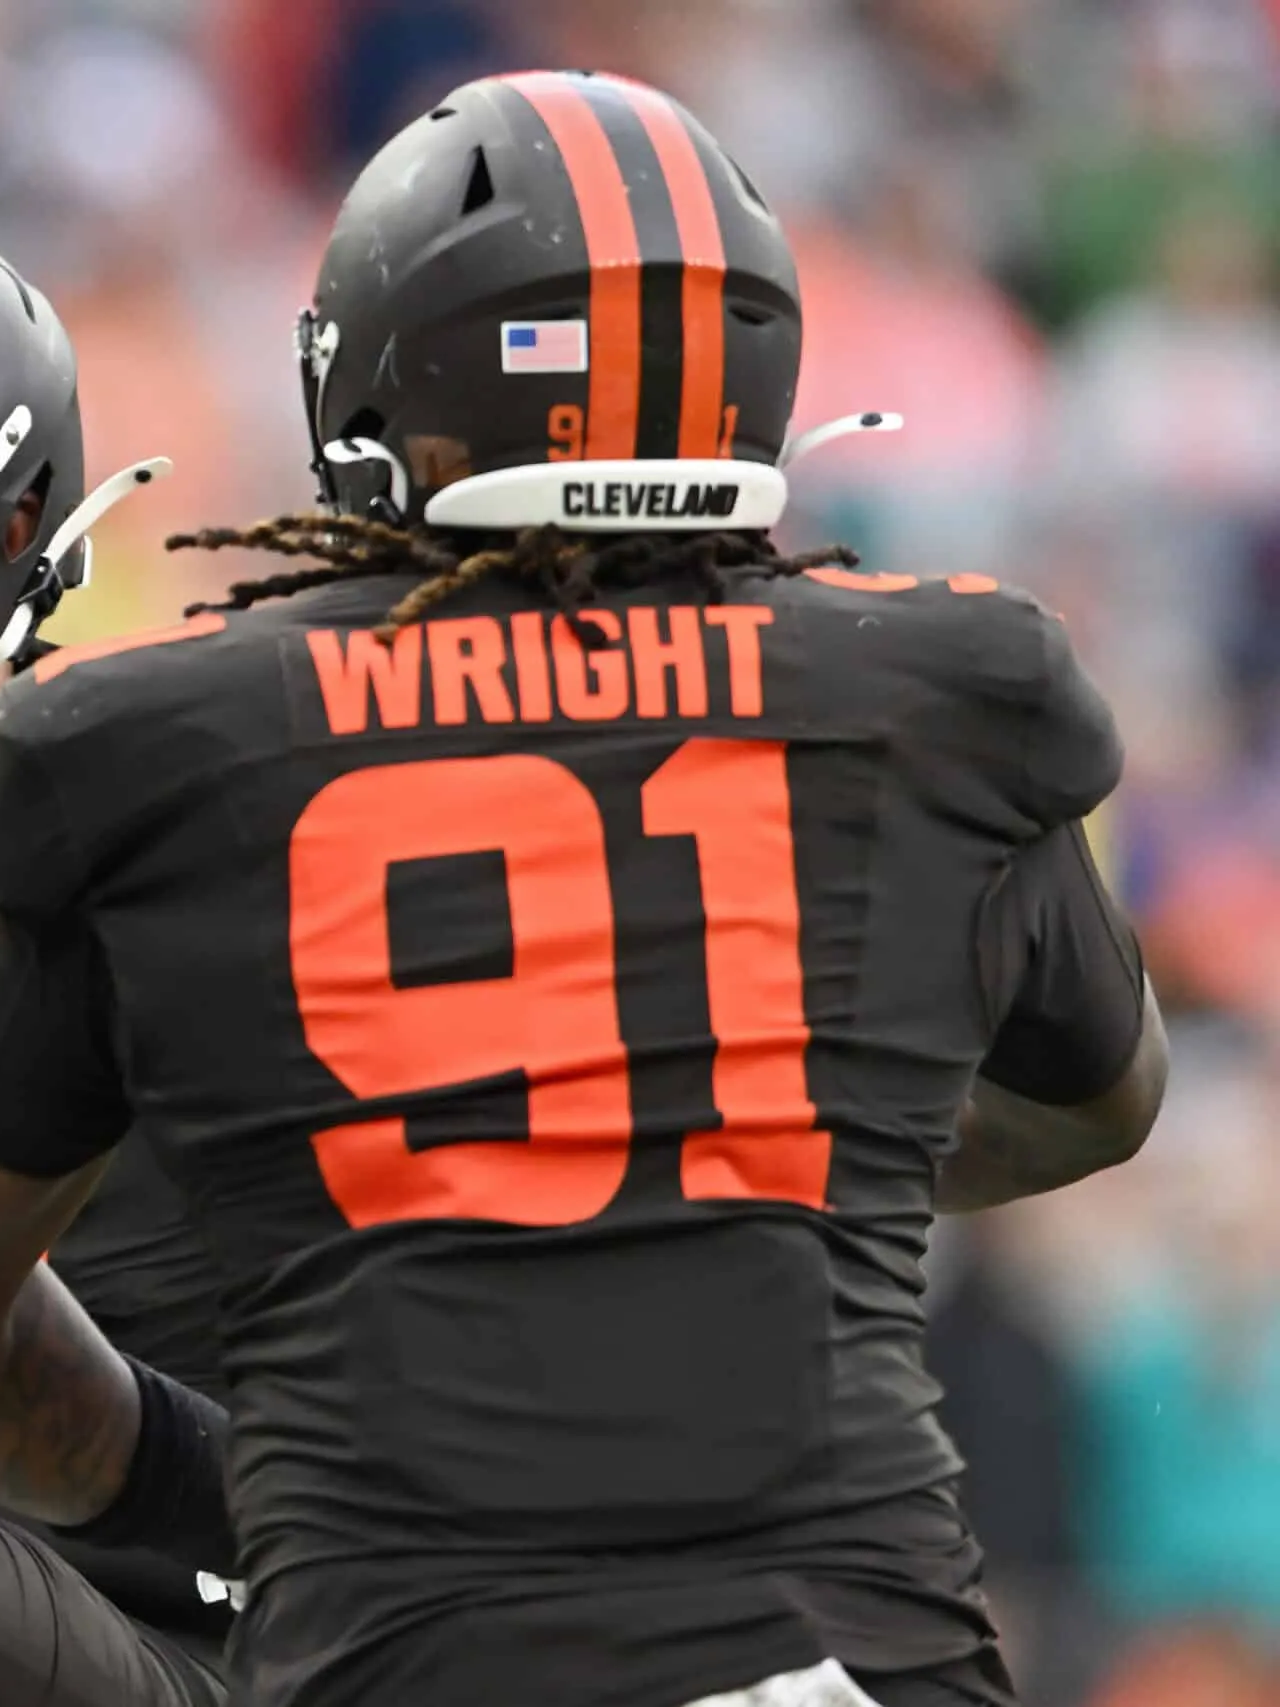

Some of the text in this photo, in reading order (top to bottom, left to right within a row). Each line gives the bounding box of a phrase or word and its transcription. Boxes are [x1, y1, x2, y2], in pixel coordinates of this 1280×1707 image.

[547, 403, 584, 462] 9
[561, 482, 740, 518] CLEVELAND
[307, 603, 773, 736] WRIGHT
[289, 737, 833, 1229] 91
